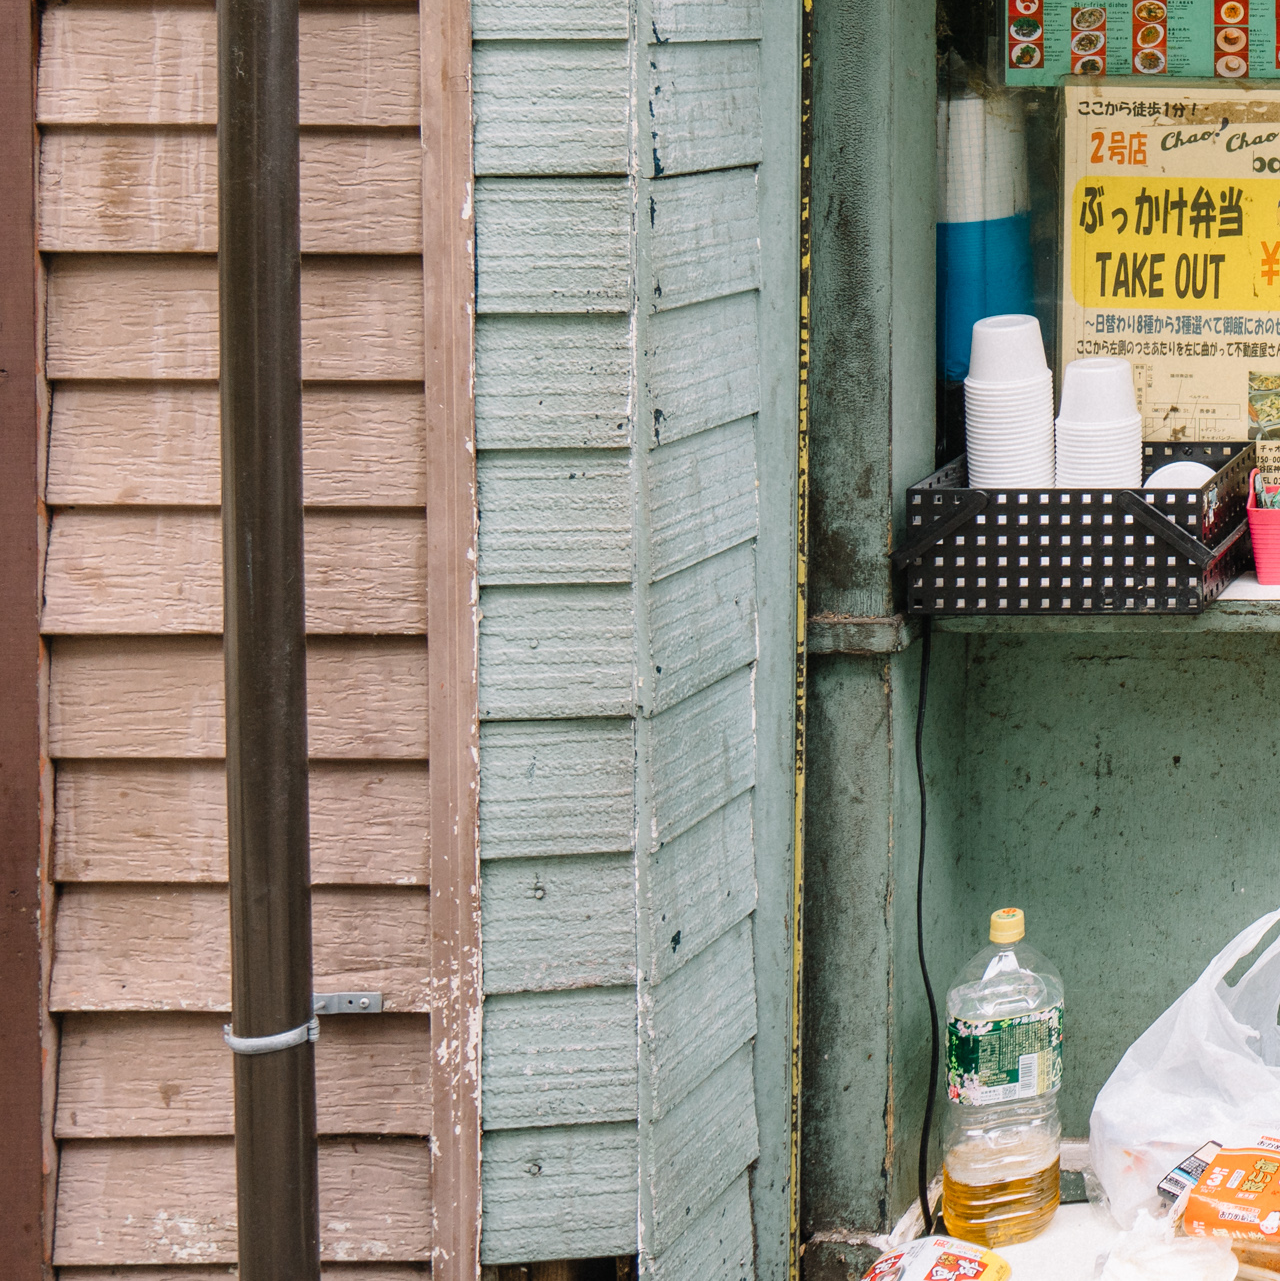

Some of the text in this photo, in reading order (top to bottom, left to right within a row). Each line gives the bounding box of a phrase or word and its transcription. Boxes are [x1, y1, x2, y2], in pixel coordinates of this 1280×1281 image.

[1090, 130, 1148, 166] 2号店
[1160, 117, 1229, 152] Chao!
[1079, 185, 1244, 239] ぶっかけ弁当
[1095, 251, 1226, 300] TAKE OUT
[1206, 1173, 1224, 1186] 3
